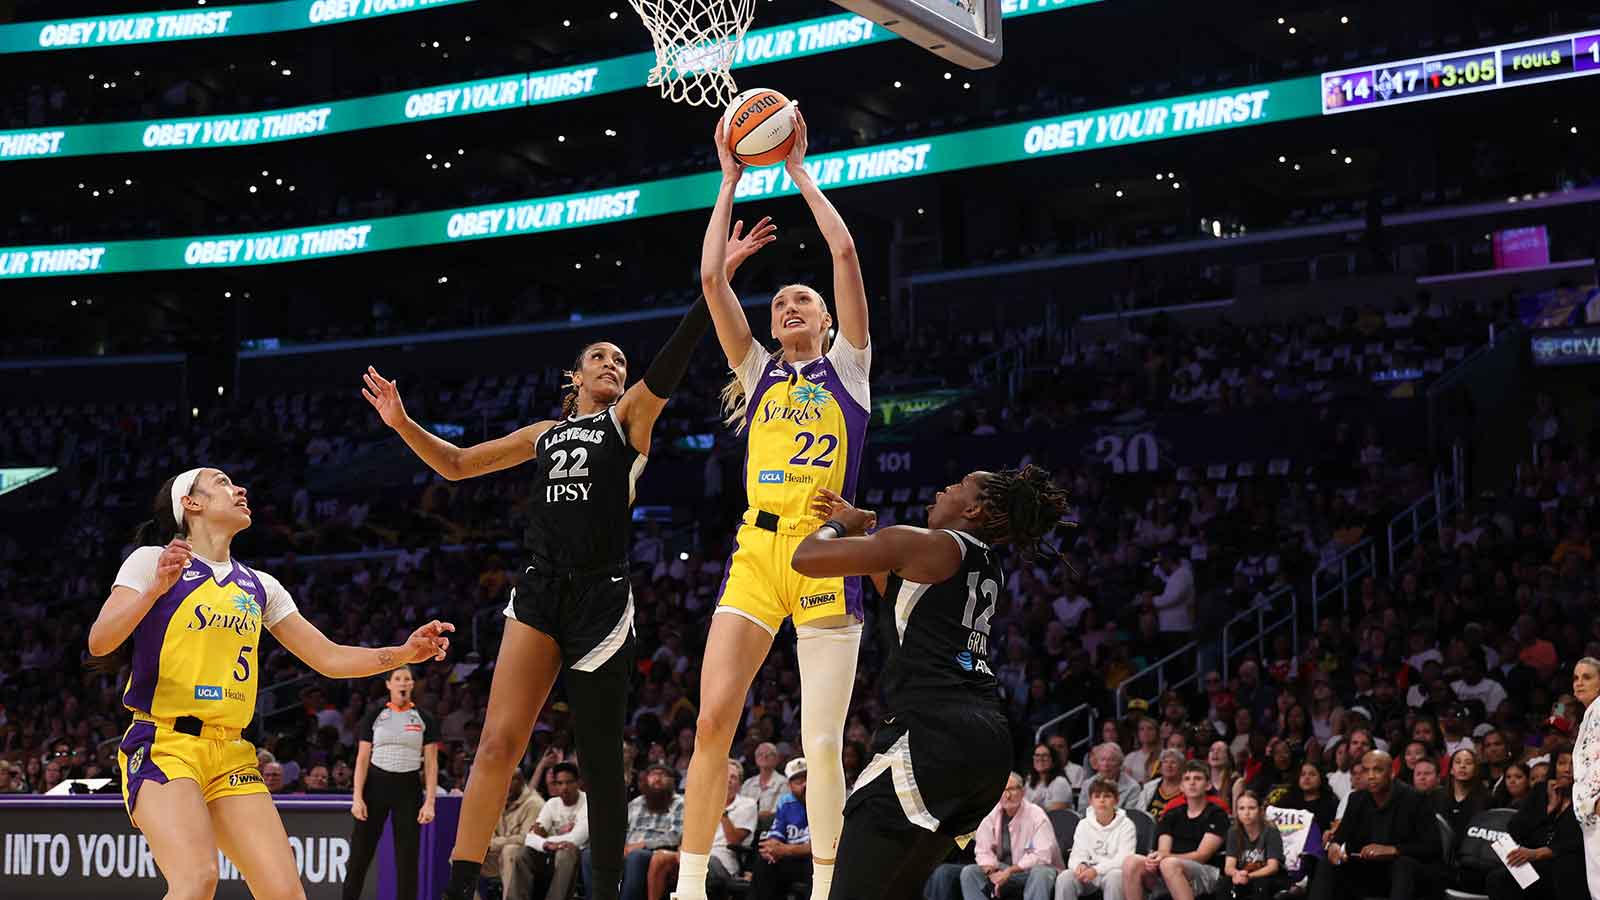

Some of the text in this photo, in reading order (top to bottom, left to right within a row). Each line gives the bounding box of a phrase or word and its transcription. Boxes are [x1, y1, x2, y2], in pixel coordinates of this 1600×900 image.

[39, 11, 232, 47] OBEY YOUR THIRST
[797, 16, 874, 52] THIRST
[1441, 58, 1496, 88] 3:05
[1512, 50, 1561, 70] FOULS
[1342, 77, 1371, 101] 14
[1392, 69, 1419, 94] 17
[405, 90, 461, 118] OBEY
[461, 80, 521, 110] YOUR
[735, 95, 779, 127] Wilson
[143, 107, 332, 147] OBEY YOUR THIRST
[1024, 90, 1270, 154] OBEY YOUR THIRST
[734, 168, 782, 198] BEY
[845, 144, 931, 181] THIRST
[447, 190, 640, 237] OBEY YOUR THIRST
[30, 247, 106, 273] THIRST
[185, 225, 371, 264] OBEY YOUR THIRST
[545, 427, 605, 450] LAS VEGAS
[788, 431, 838, 468] 22
[548, 446, 589, 479] 22
[761, 471, 814, 484] UCLA Health
[546, 482, 592, 503] IPSY
[808, 593, 836, 606] WNBA
[961, 571, 998, 636] 12
[233, 646, 253, 683] 5
[198, 687, 246, 702] UCLA Health
[4, 834, 70, 877] INTO
[77, 834, 157, 878] YOUR
